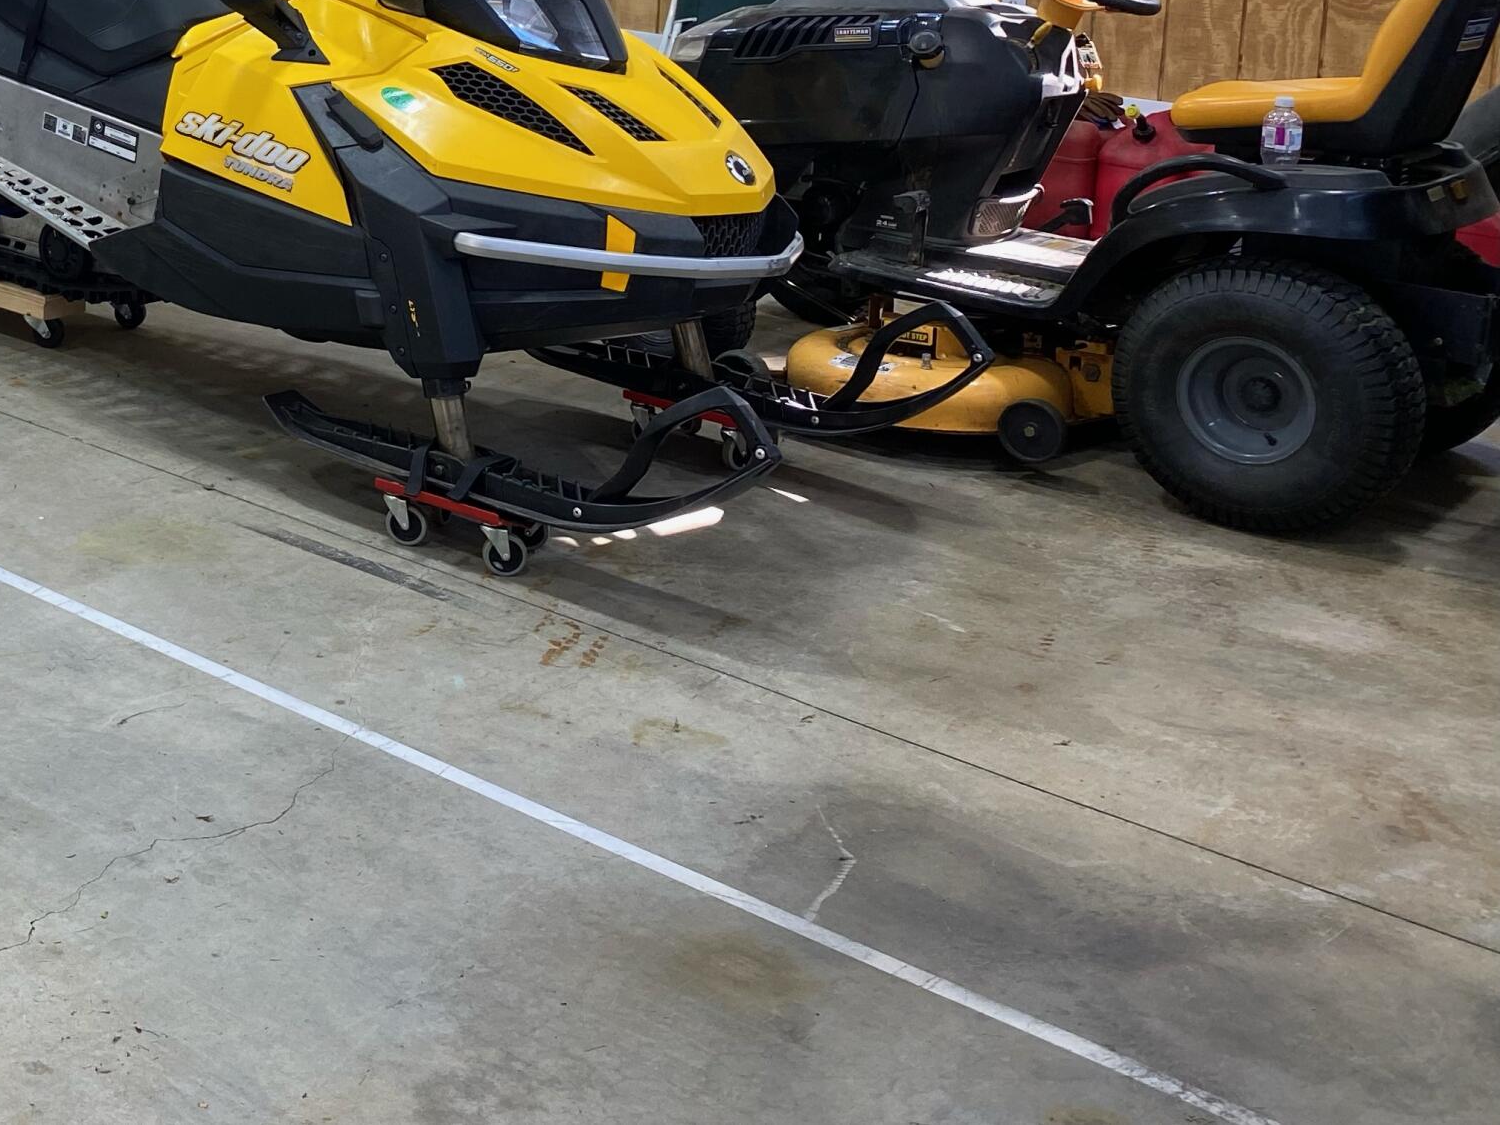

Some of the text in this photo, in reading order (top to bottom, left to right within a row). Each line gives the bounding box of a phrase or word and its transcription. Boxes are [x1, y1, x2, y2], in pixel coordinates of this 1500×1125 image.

[175, 111, 311, 174] ski-doo
[224, 155, 293, 192] TUNDRA
[911, 332, 928, 341] STEP
